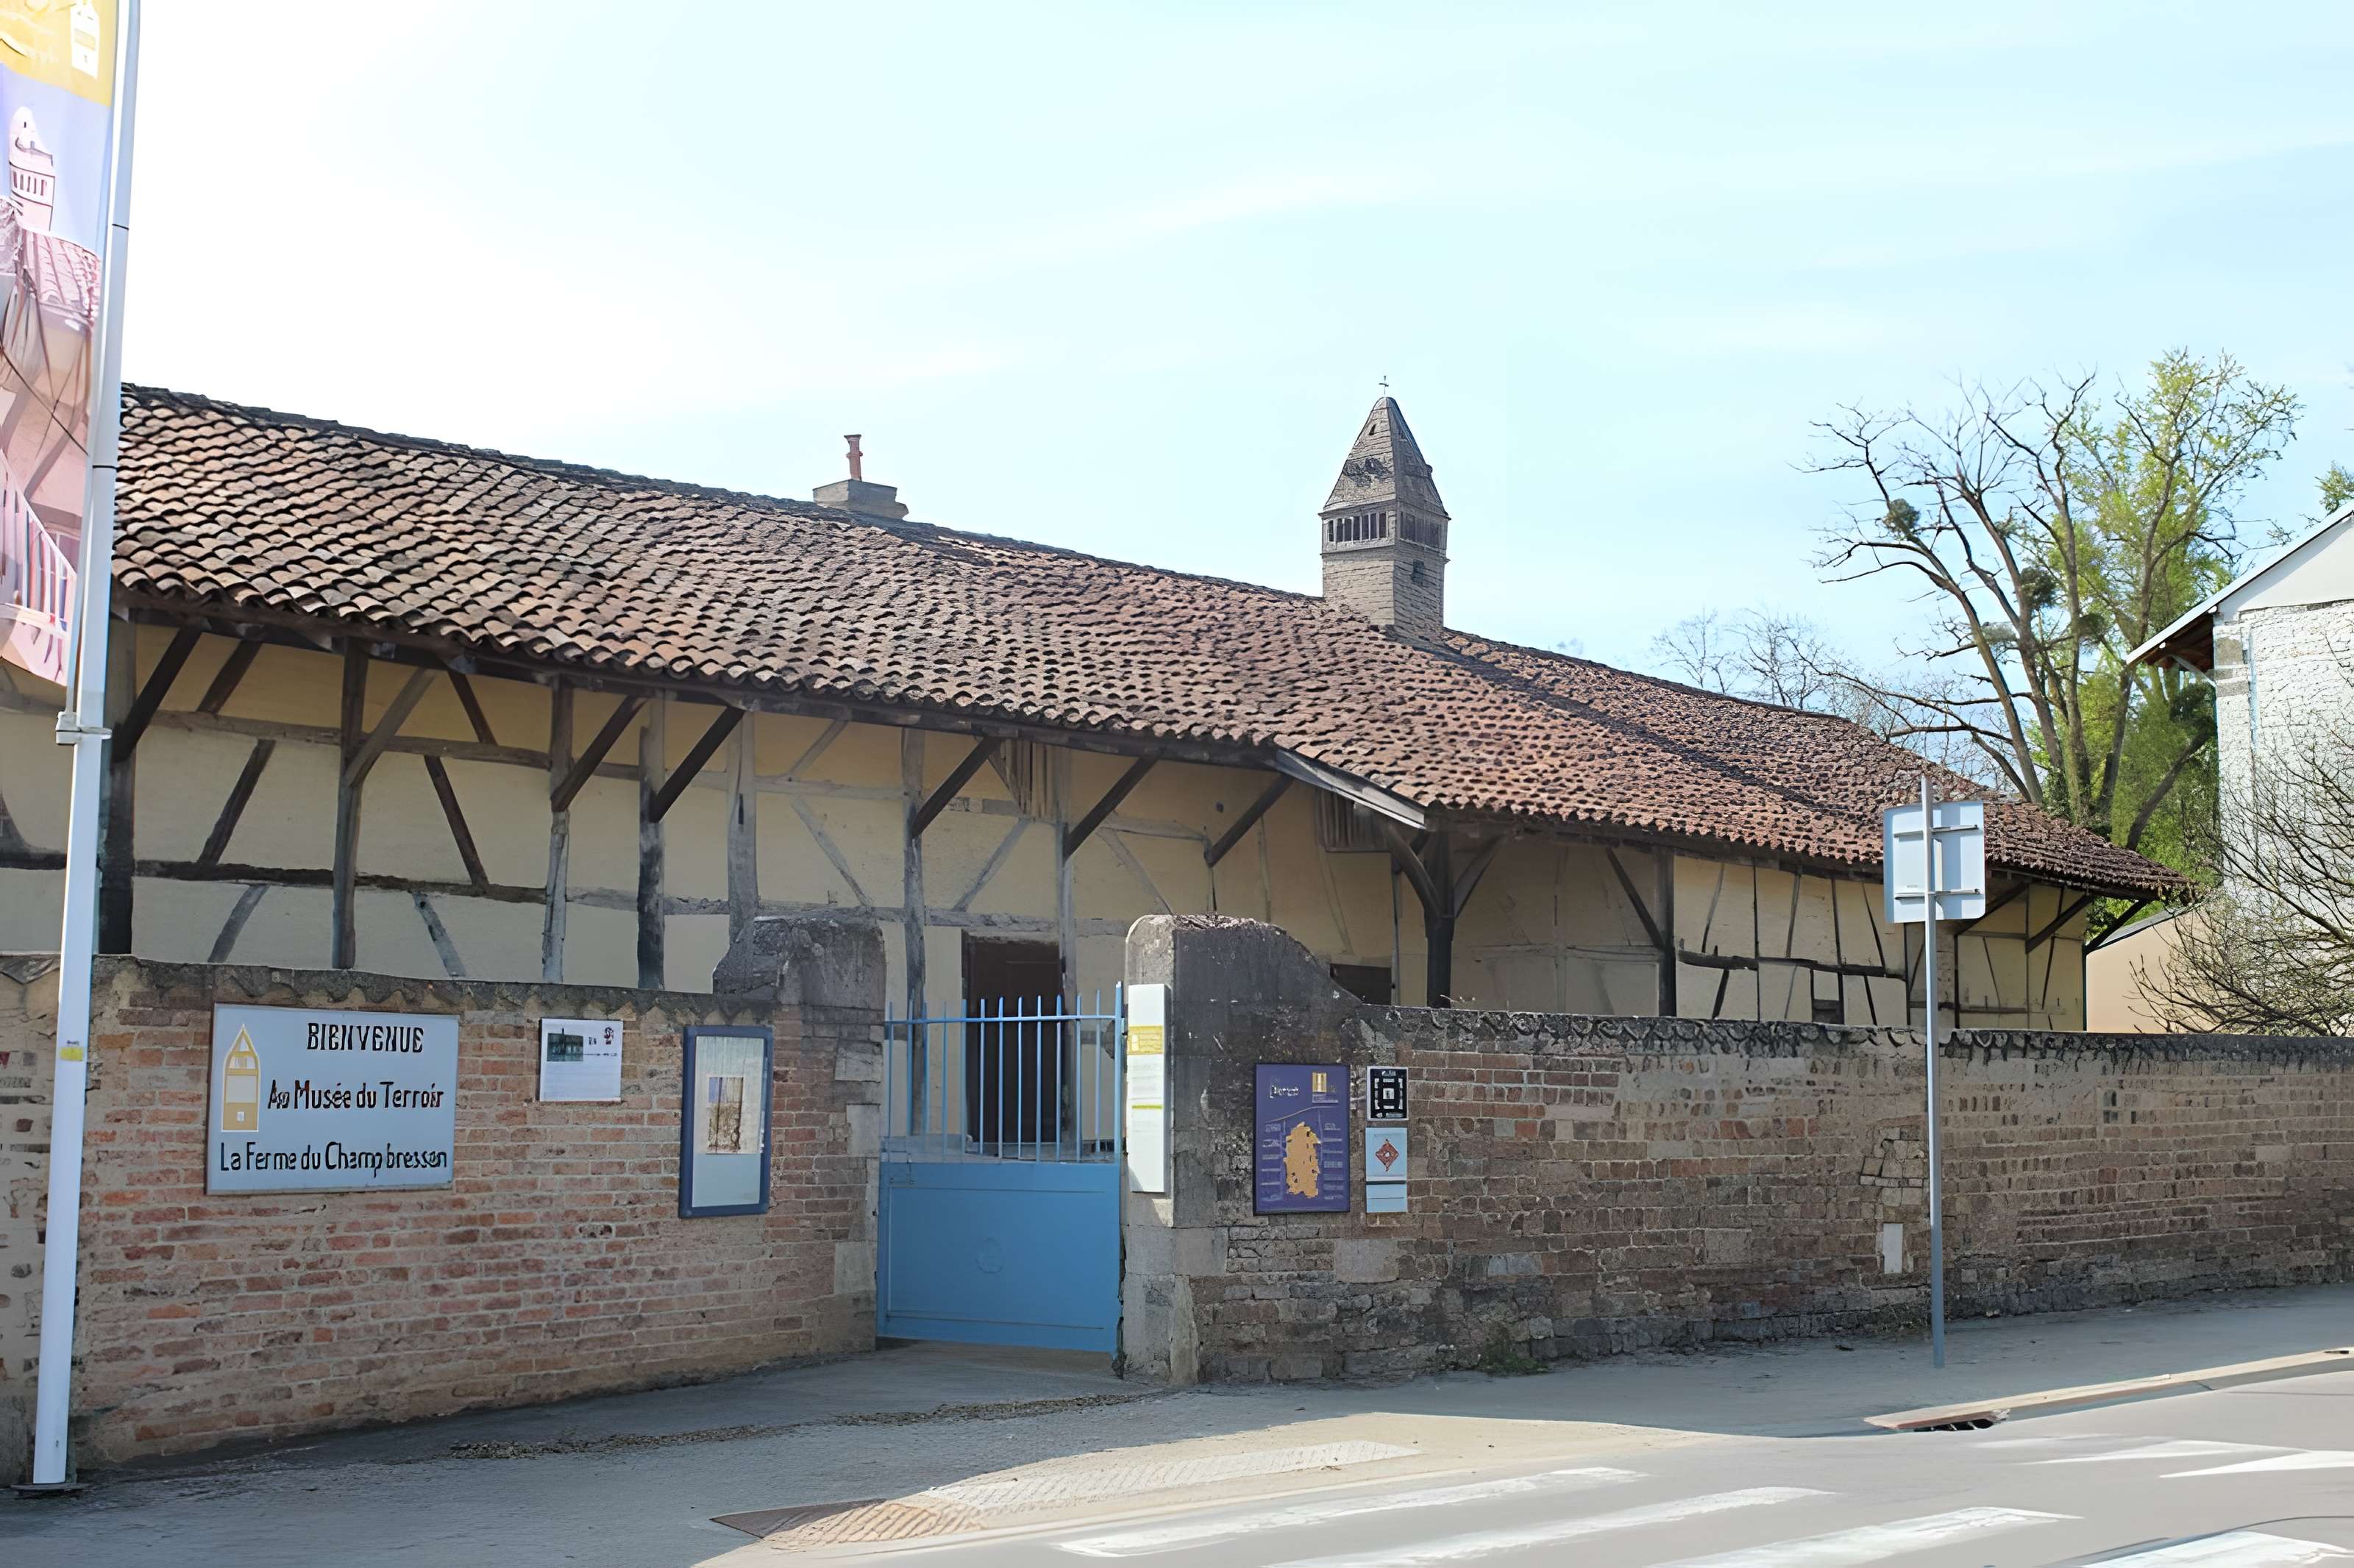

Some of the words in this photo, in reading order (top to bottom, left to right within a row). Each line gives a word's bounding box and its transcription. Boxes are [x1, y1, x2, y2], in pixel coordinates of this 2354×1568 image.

[307, 1022, 424, 1053] BIENVENUE
[294, 1080, 351, 1109] Musée
[356, 1083, 377, 1108] du
[380, 1081, 444, 1108] Terroir
[221, 1142, 241, 1171] La
[246, 1141, 297, 1170] Ferme
[301, 1144, 321, 1170] du
